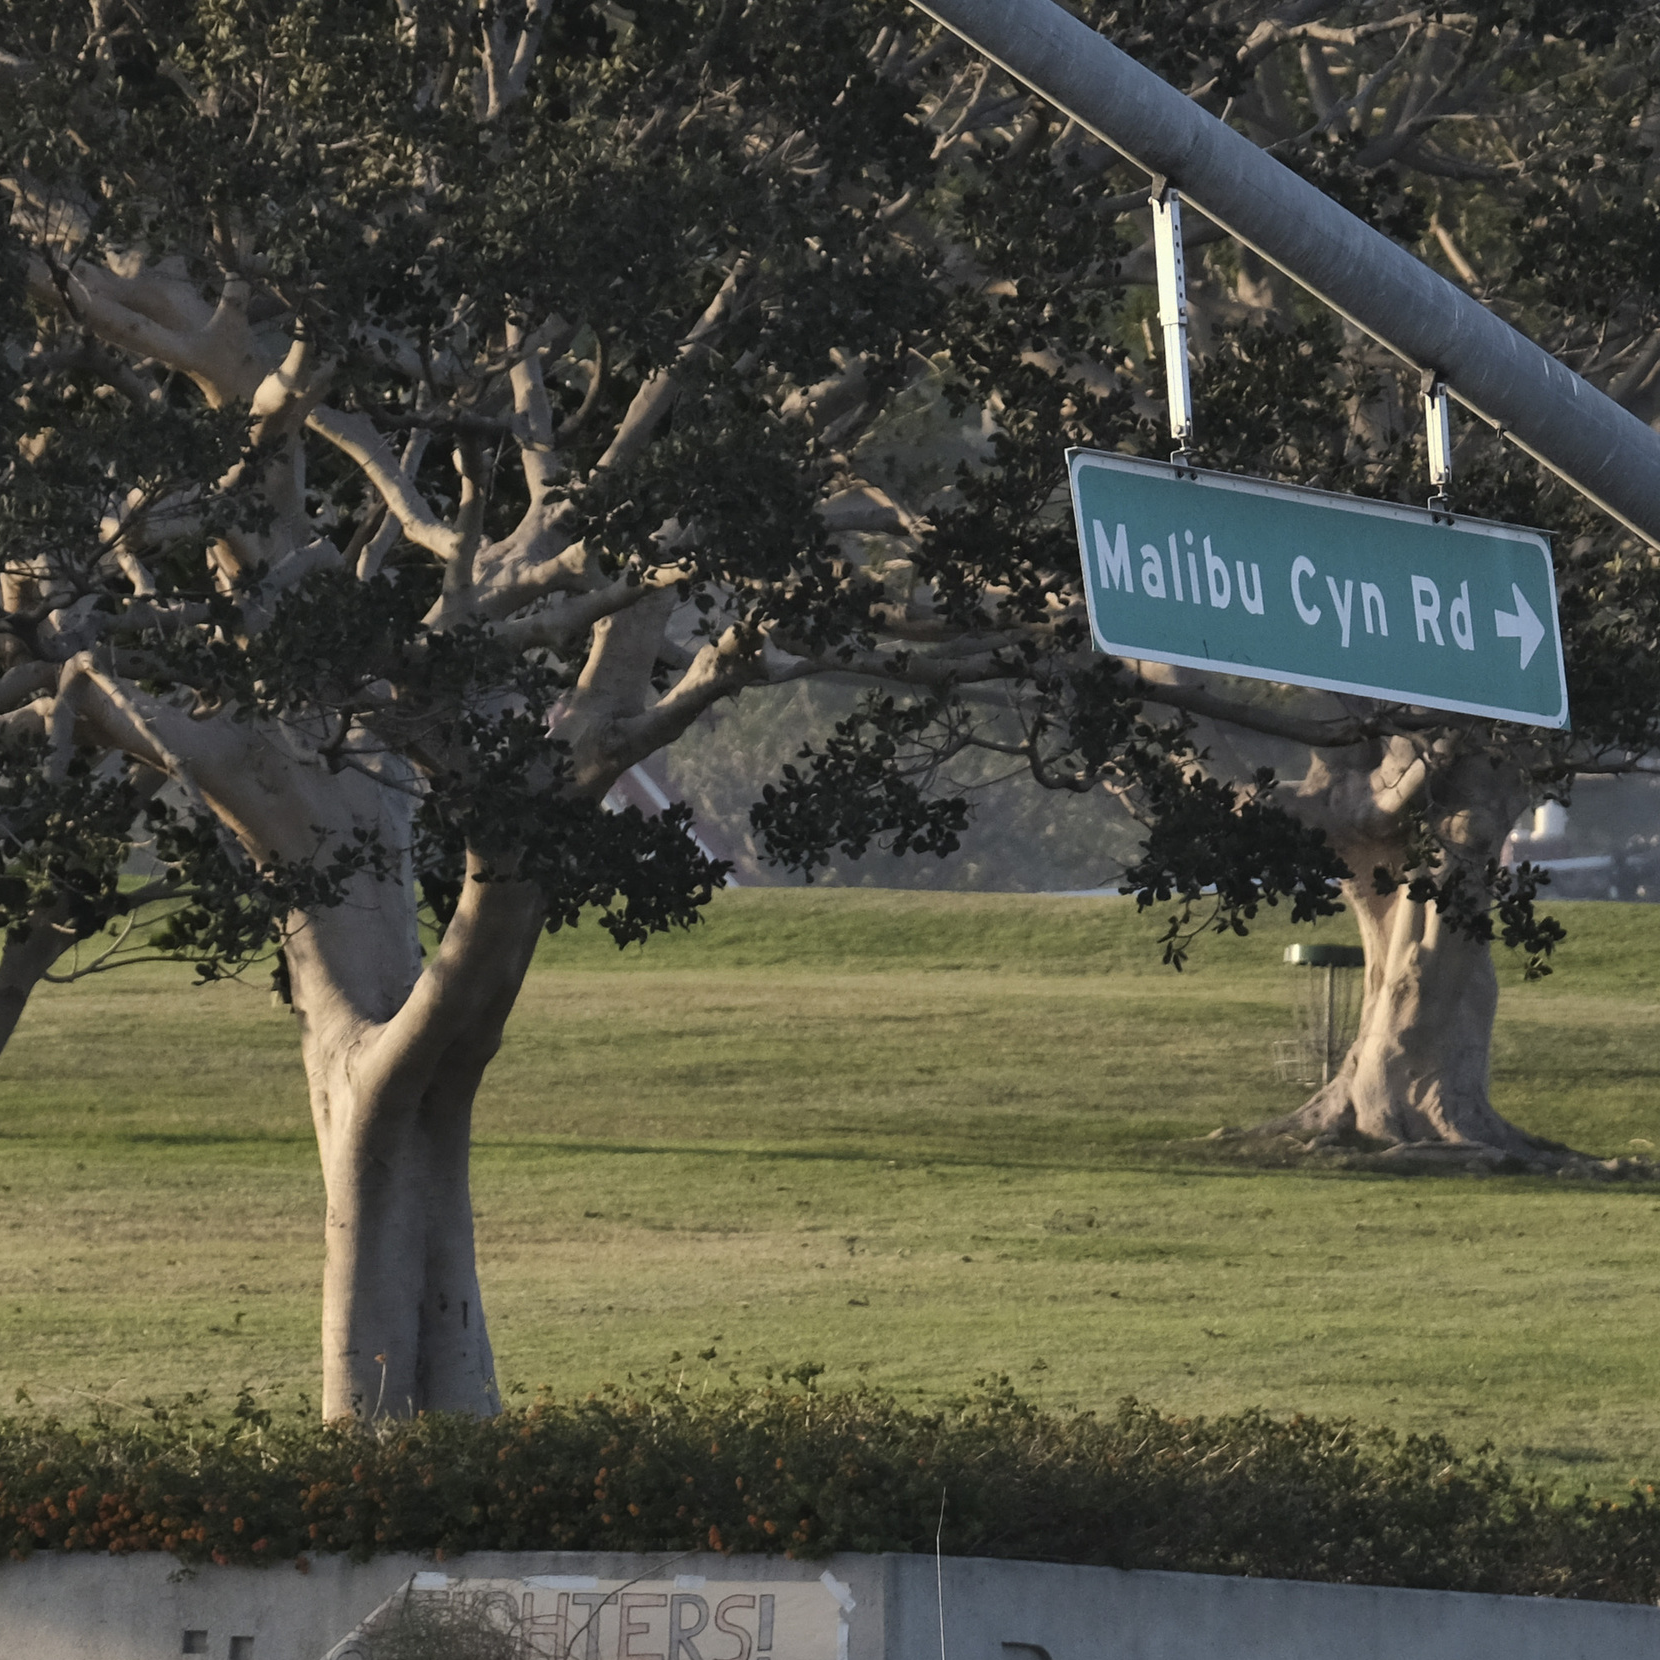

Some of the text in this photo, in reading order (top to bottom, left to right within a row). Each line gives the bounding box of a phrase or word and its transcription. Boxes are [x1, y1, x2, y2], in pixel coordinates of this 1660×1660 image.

[1092, 518, 1475, 652] Malibu Cyn Rd
